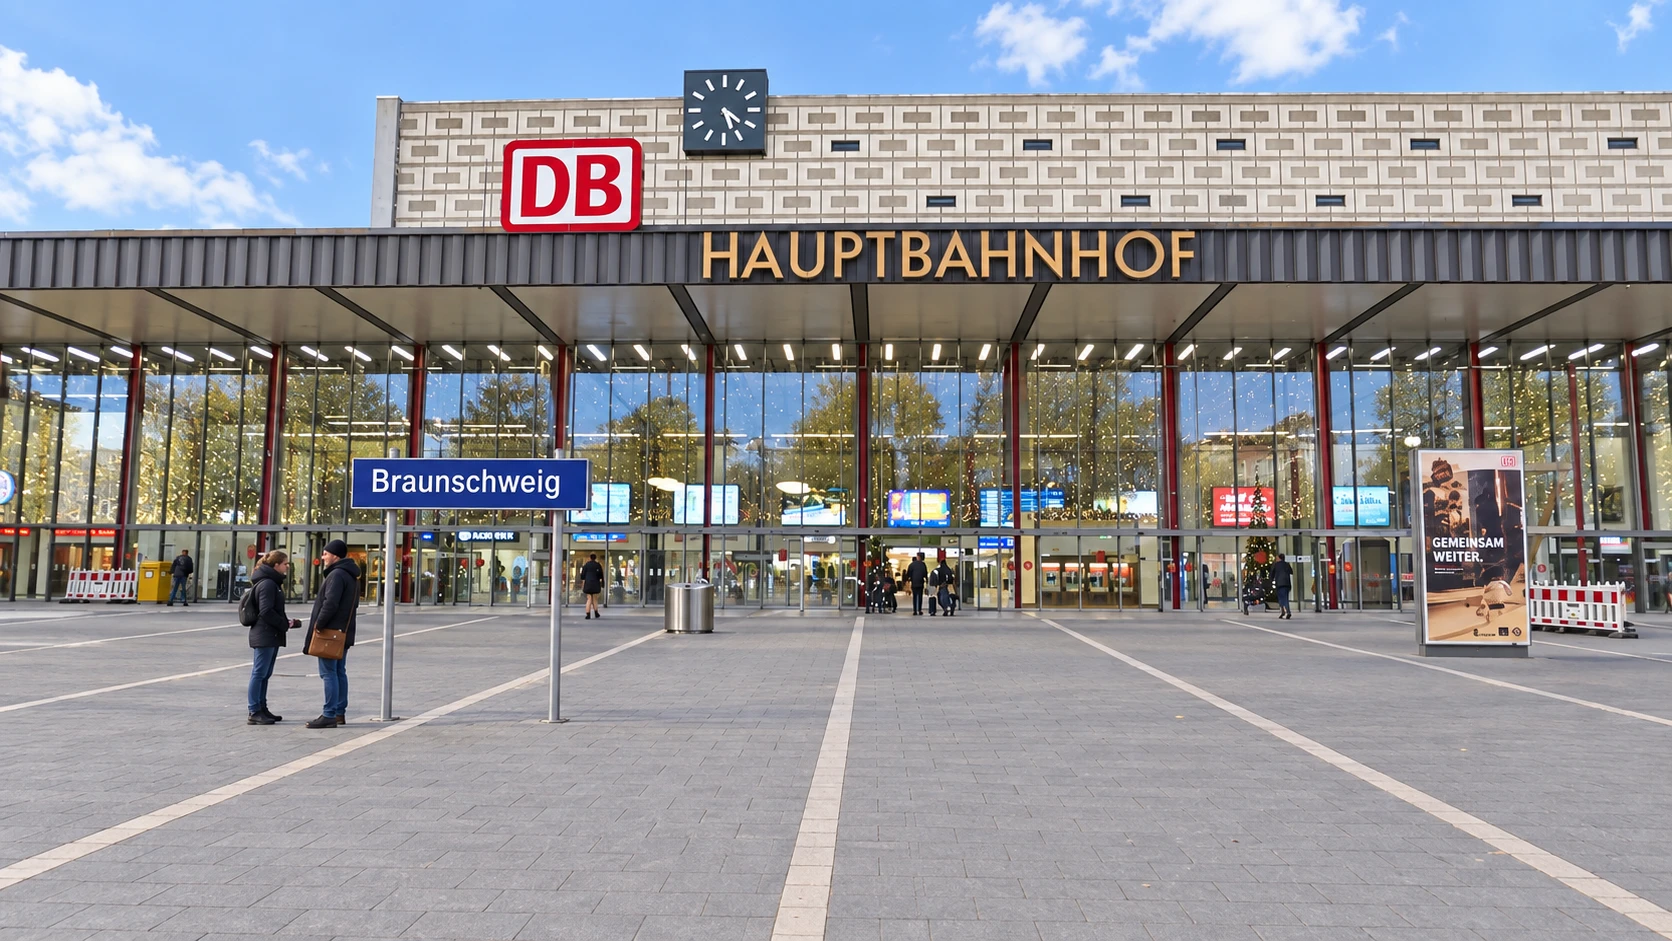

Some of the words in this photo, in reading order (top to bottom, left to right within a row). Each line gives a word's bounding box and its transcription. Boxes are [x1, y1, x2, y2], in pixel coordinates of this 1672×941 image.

[521, 154, 622, 217] DB
[702, 230, 1196, 281] HAUPTBAHNHOF
[372, 468, 560, 500] Braunschweig
[1432, 537, 1504, 549] GEMEINSAM
[1433, 551, 1484, 563] WEITER.
